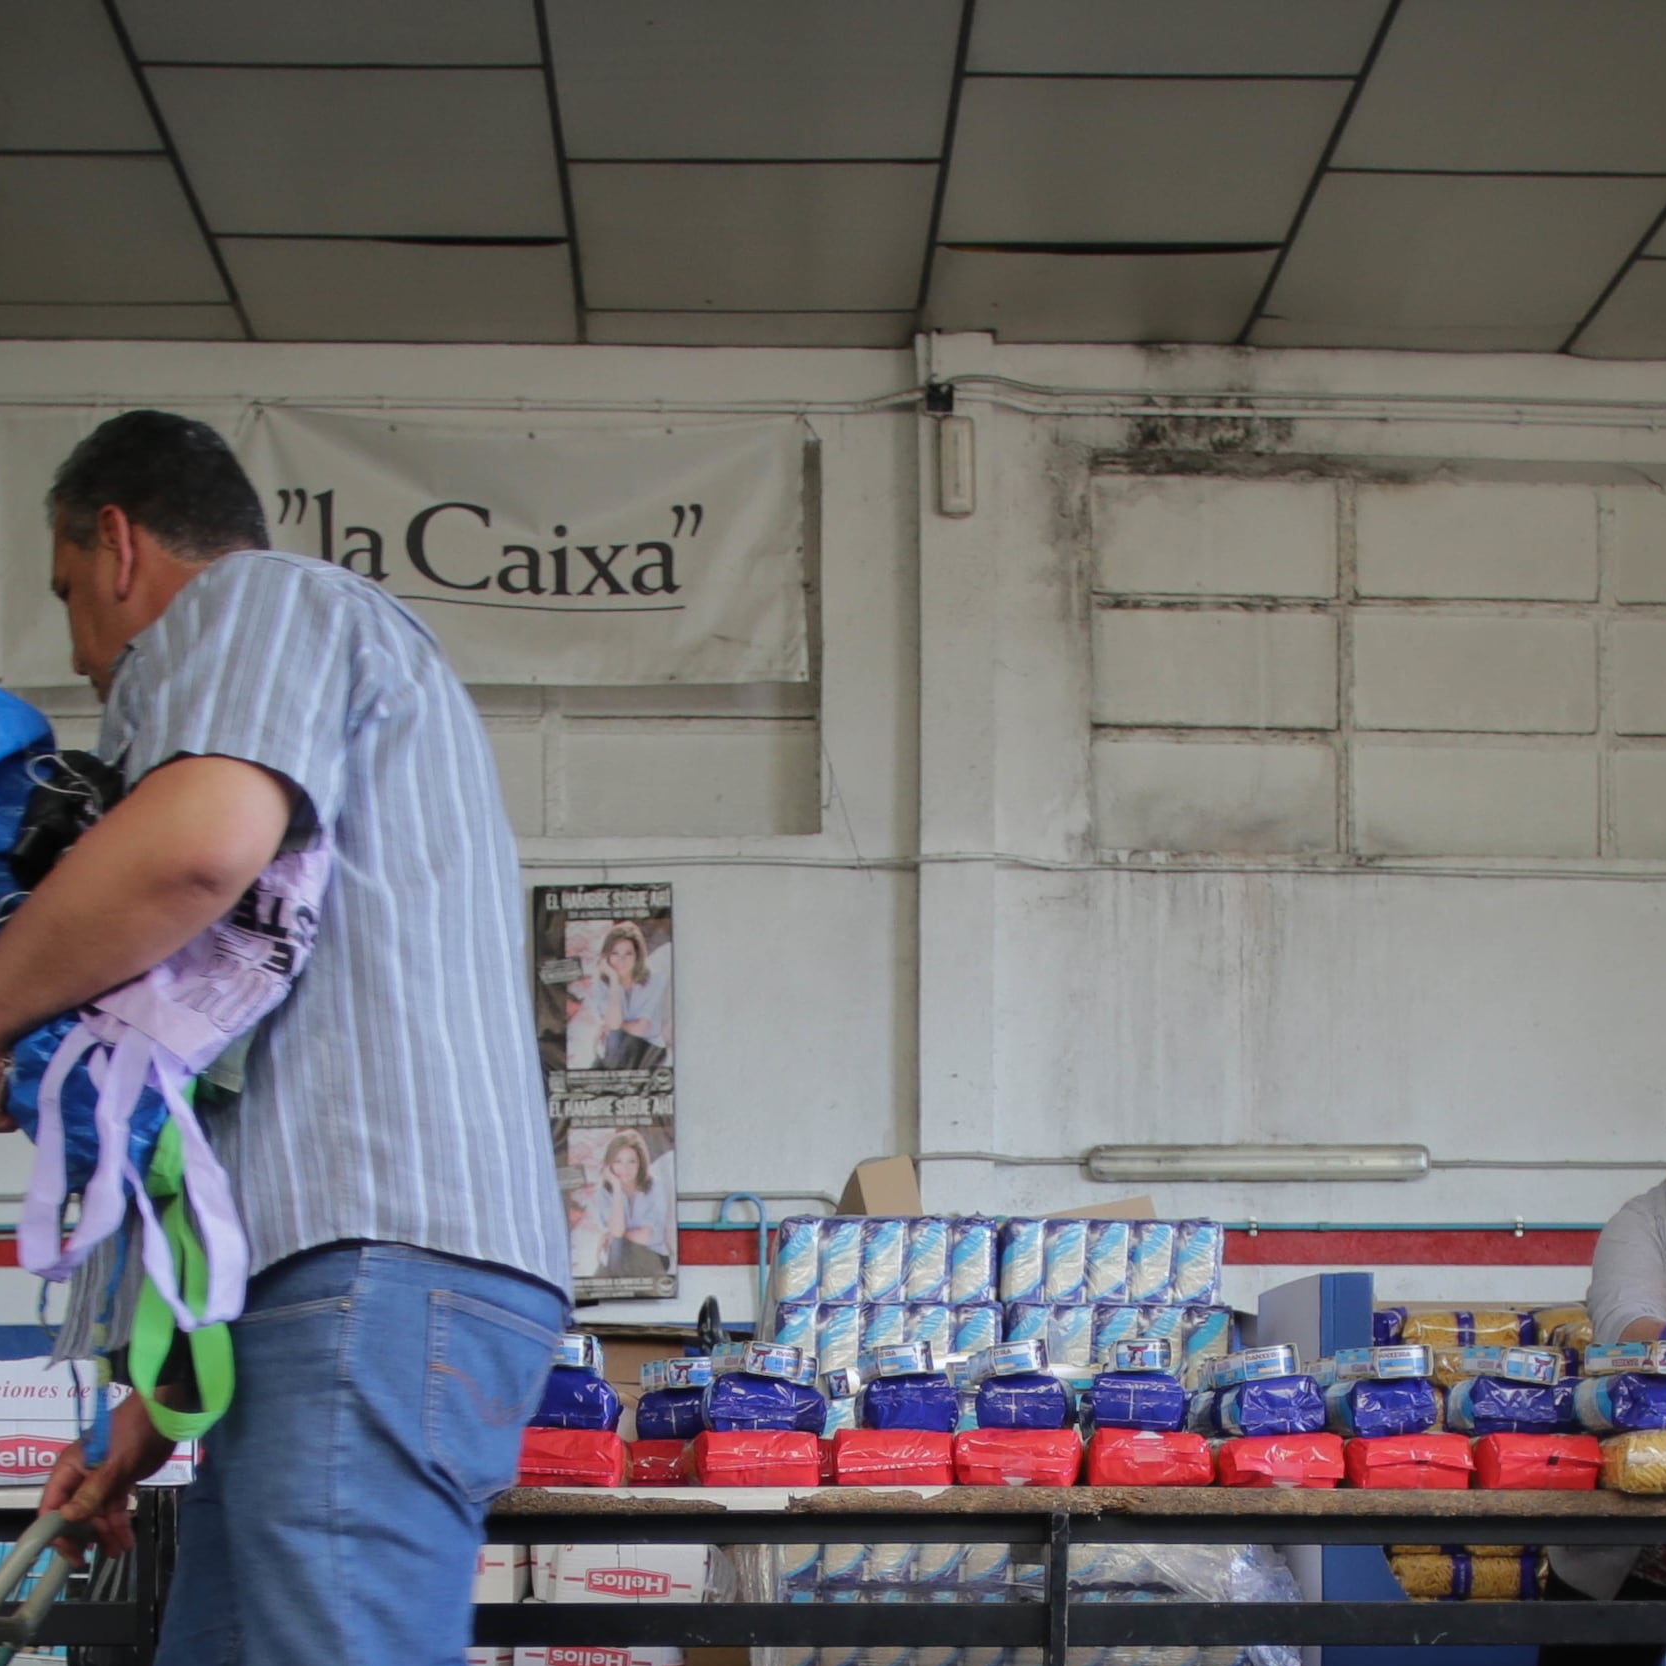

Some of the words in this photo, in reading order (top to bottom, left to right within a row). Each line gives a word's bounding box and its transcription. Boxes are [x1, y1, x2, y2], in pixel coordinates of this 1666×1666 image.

[549, 1101, 562, 1117] EL
[616, 1098, 651, 1116] SIGUE
[67, 1380, 91, 1399] de
[591, 1573, 664, 1592] Helios
